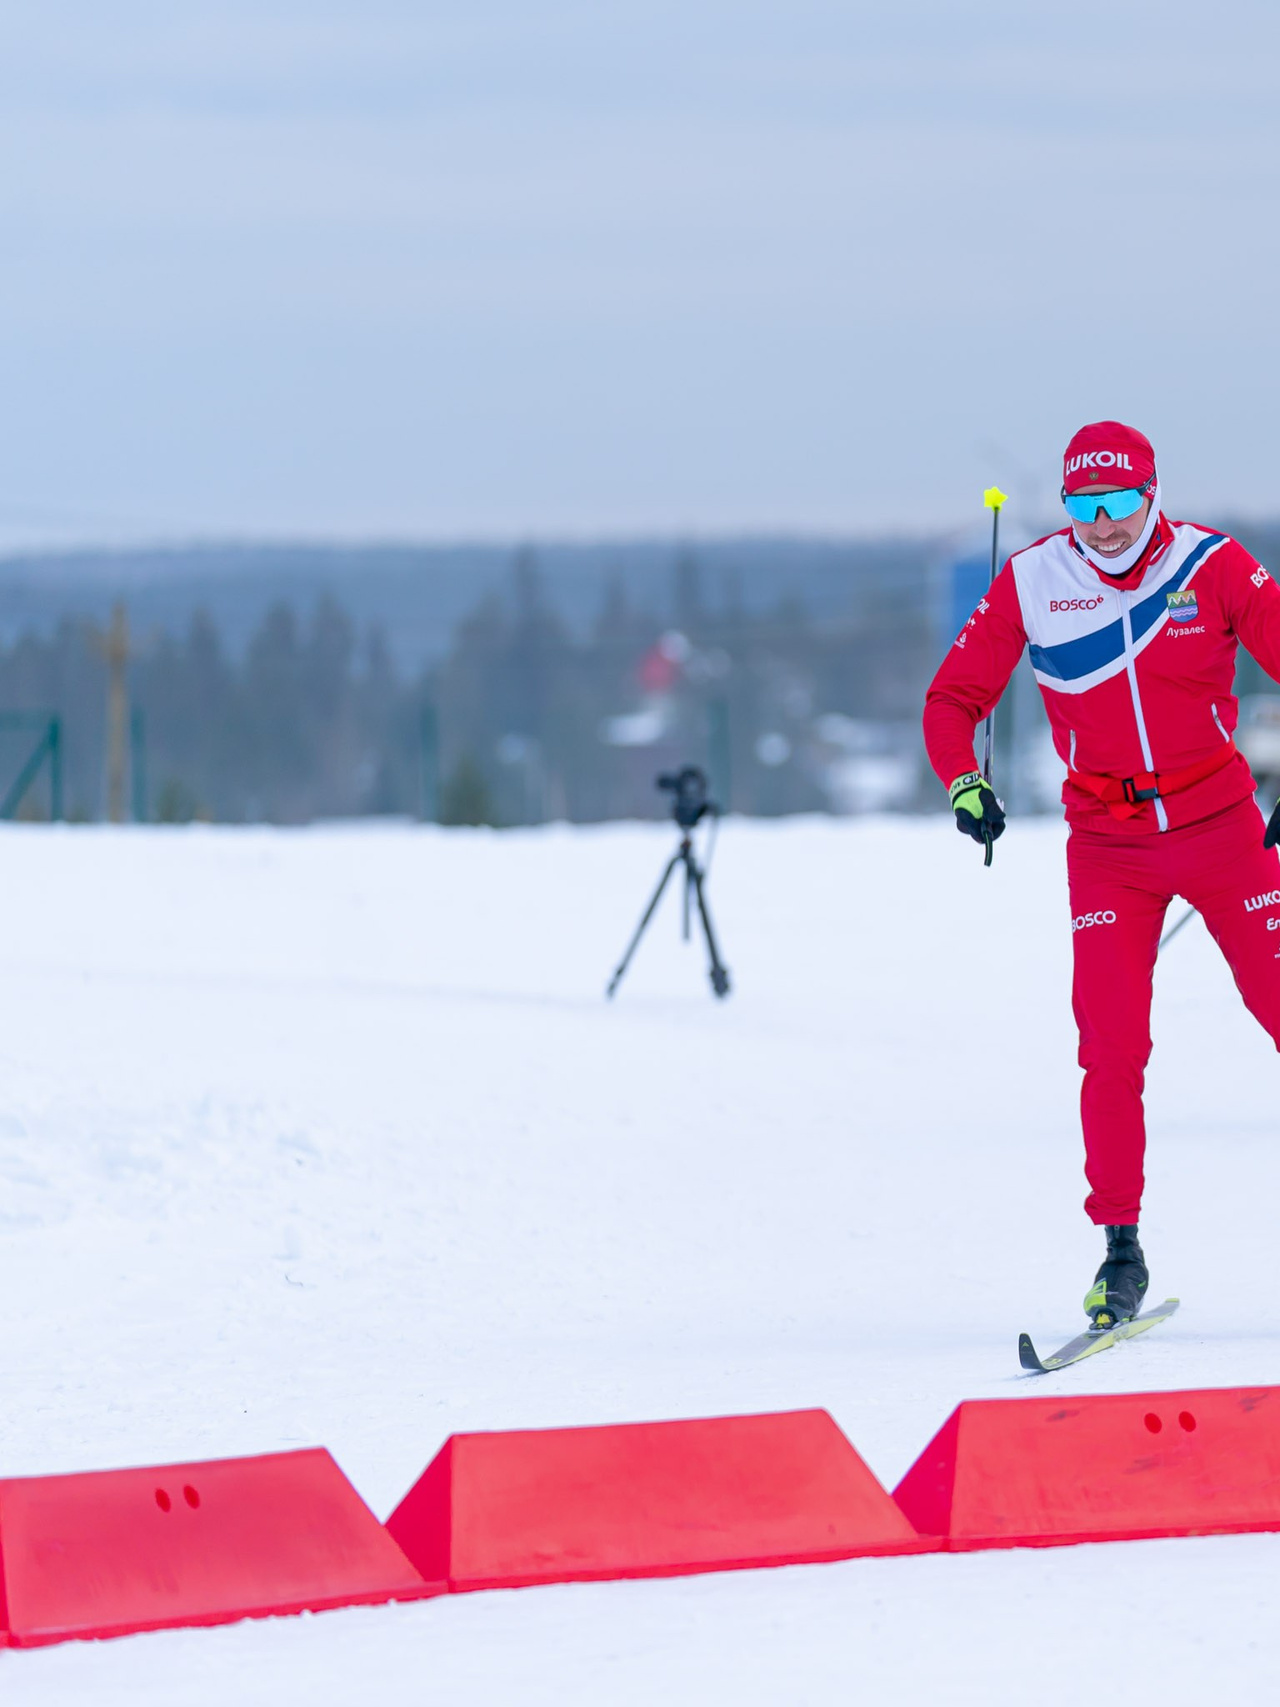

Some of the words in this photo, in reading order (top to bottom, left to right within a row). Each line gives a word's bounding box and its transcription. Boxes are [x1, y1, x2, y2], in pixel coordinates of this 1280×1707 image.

[1066, 450, 1133, 477] LUKOIL
[1050, 598, 1098, 612] BOSCO
[1166, 625, 1206, 638] Лузалес
